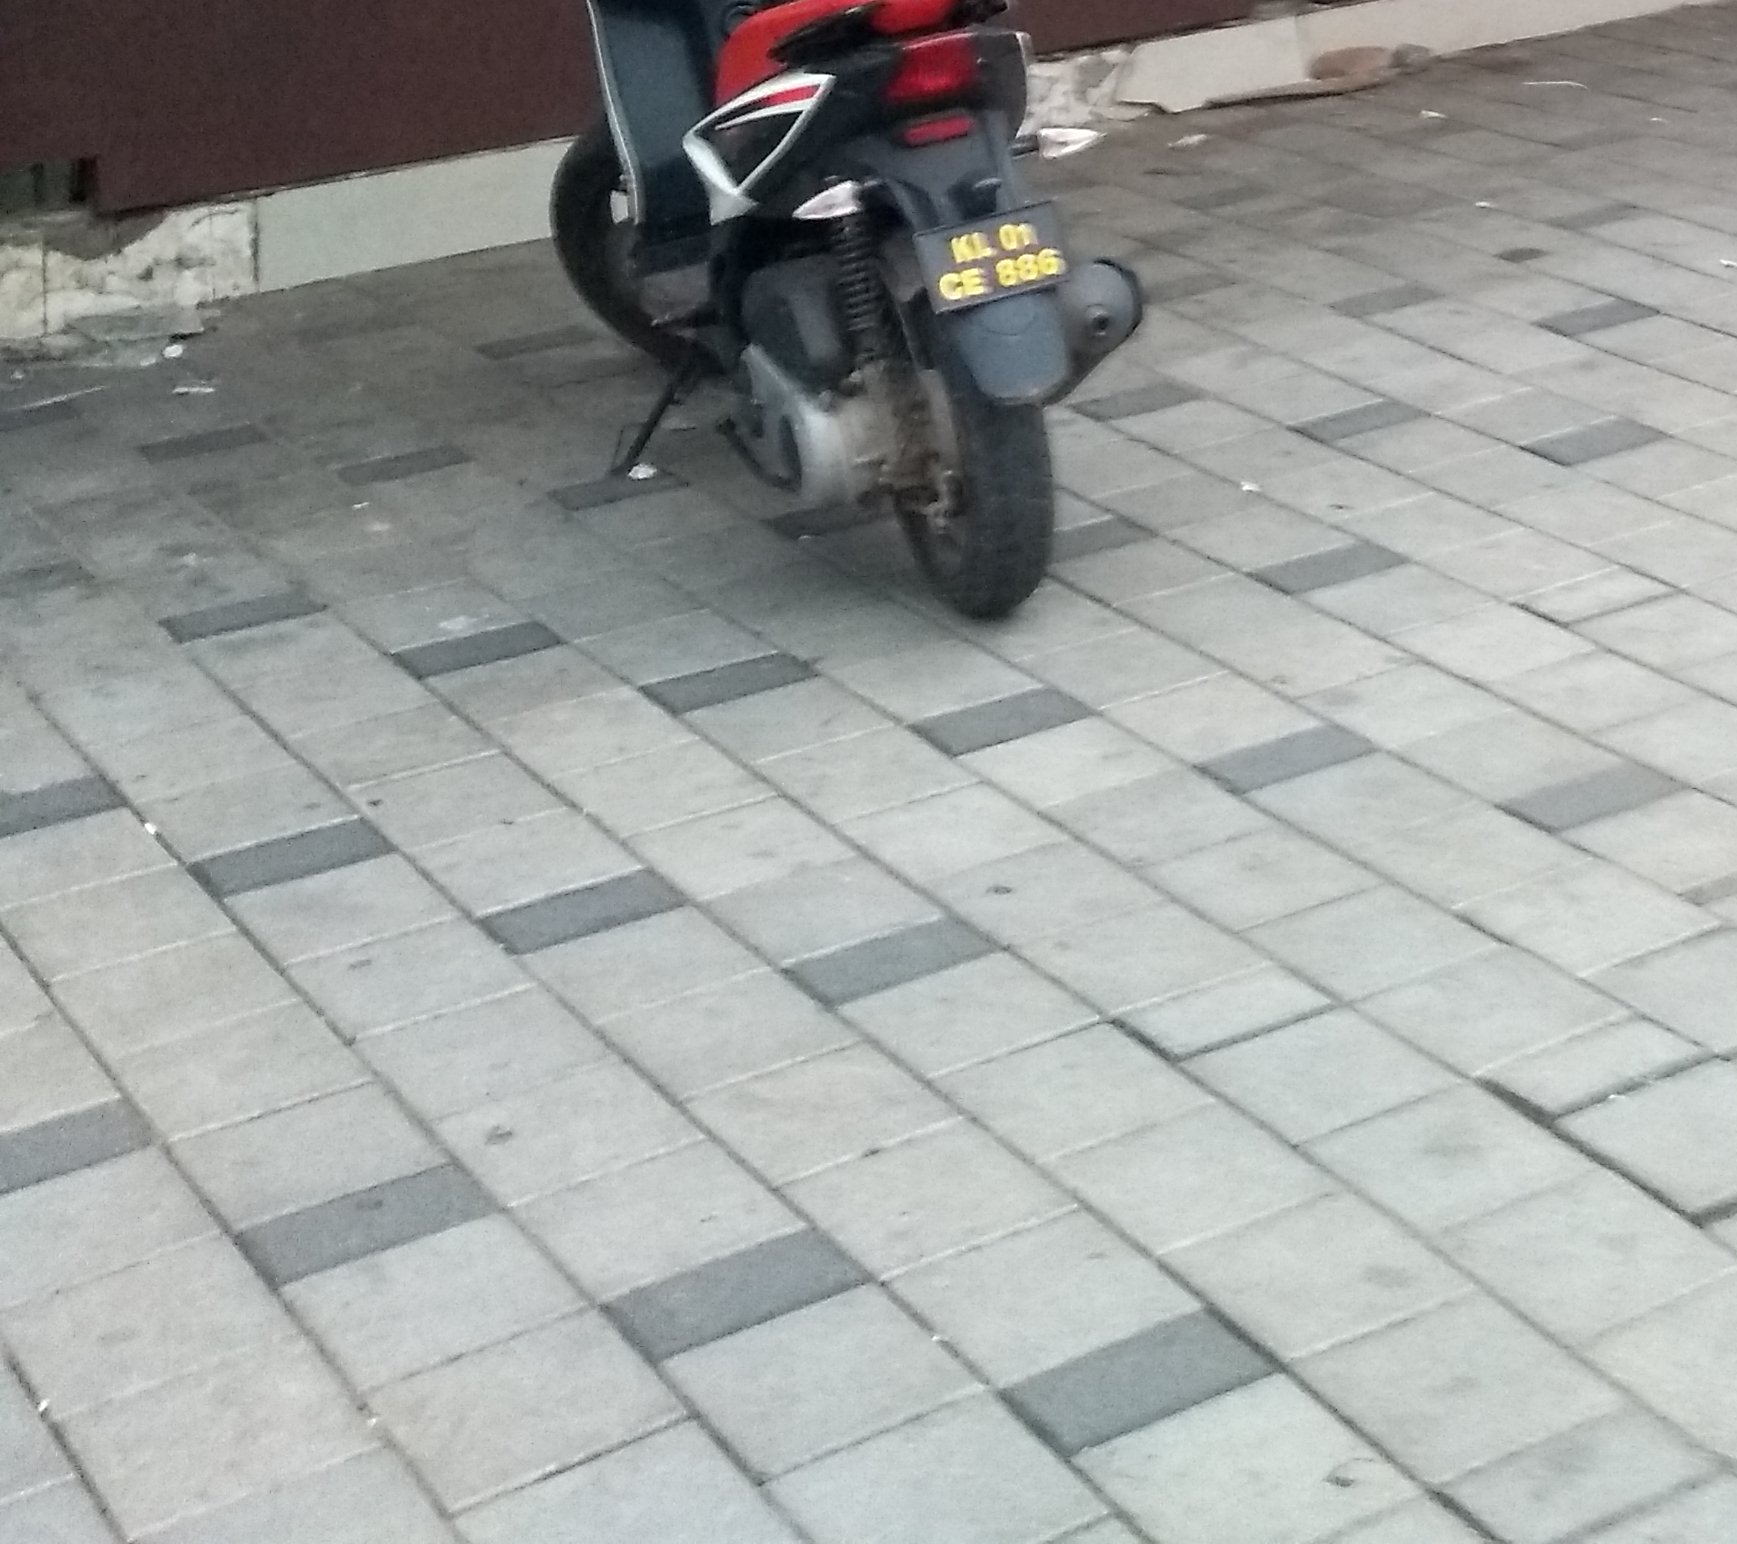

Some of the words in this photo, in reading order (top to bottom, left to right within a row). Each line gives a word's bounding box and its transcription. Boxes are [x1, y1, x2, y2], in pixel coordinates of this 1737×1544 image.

[950, 231, 997, 264] KL
[999, 222, 1038, 251] 01
[939, 267, 992, 300] CE
[995, 247, 1067, 287] 886
